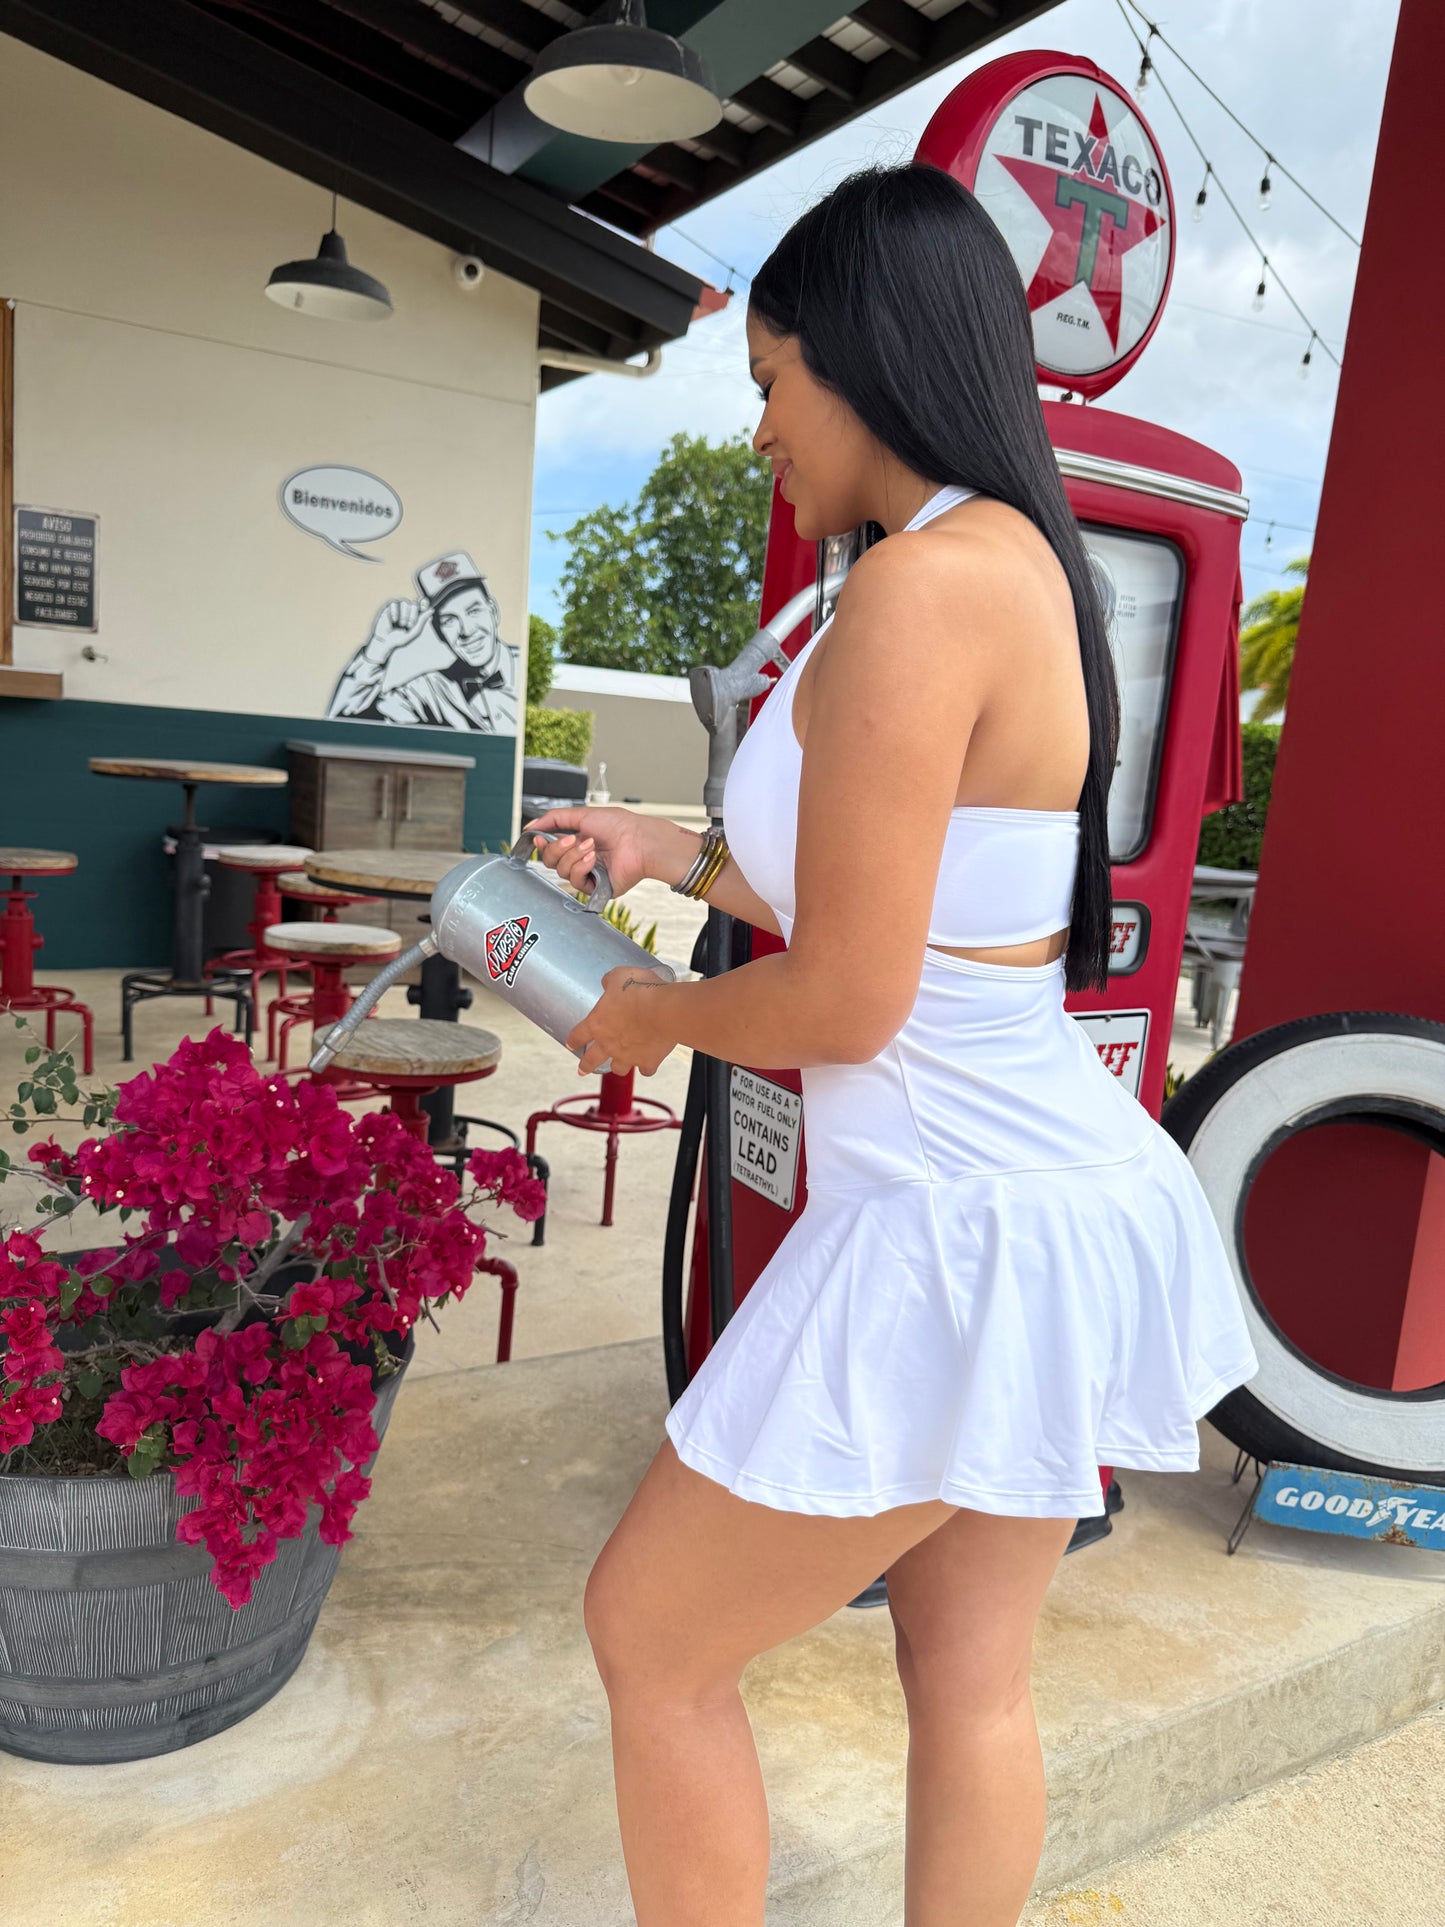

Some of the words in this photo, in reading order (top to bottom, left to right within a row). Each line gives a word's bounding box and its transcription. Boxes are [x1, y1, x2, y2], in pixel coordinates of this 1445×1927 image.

[1014, 115, 1162, 206] TEXACO
[1055, 174, 1129, 288] T
[1056, 312, 1076, 326] REG.
[292, 488, 393, 518] Bienvenidos
[42, 516, 72, 532] AVISO
[507, 965, 517, 982] BAR
[517, 938, 536, 960] GRILL
[732, 1087, 755, 1109] MOTOR
[757, 1101, 775, 1120] FUEL
[777, 1111, 797, 1129] ONLY
[740, 1075, 754, 1092] FOR
[755, 1083, 770, 1100] USE
[771, 1092, 783, 1106] AS
[784, 1098, 790, 1109] A
[734, 1110, 790, 1153] CONTAINS
[738, 1136, 778, 1175] LEAD
[732, 1160, 780, 1197] (TETRAETHYL)
